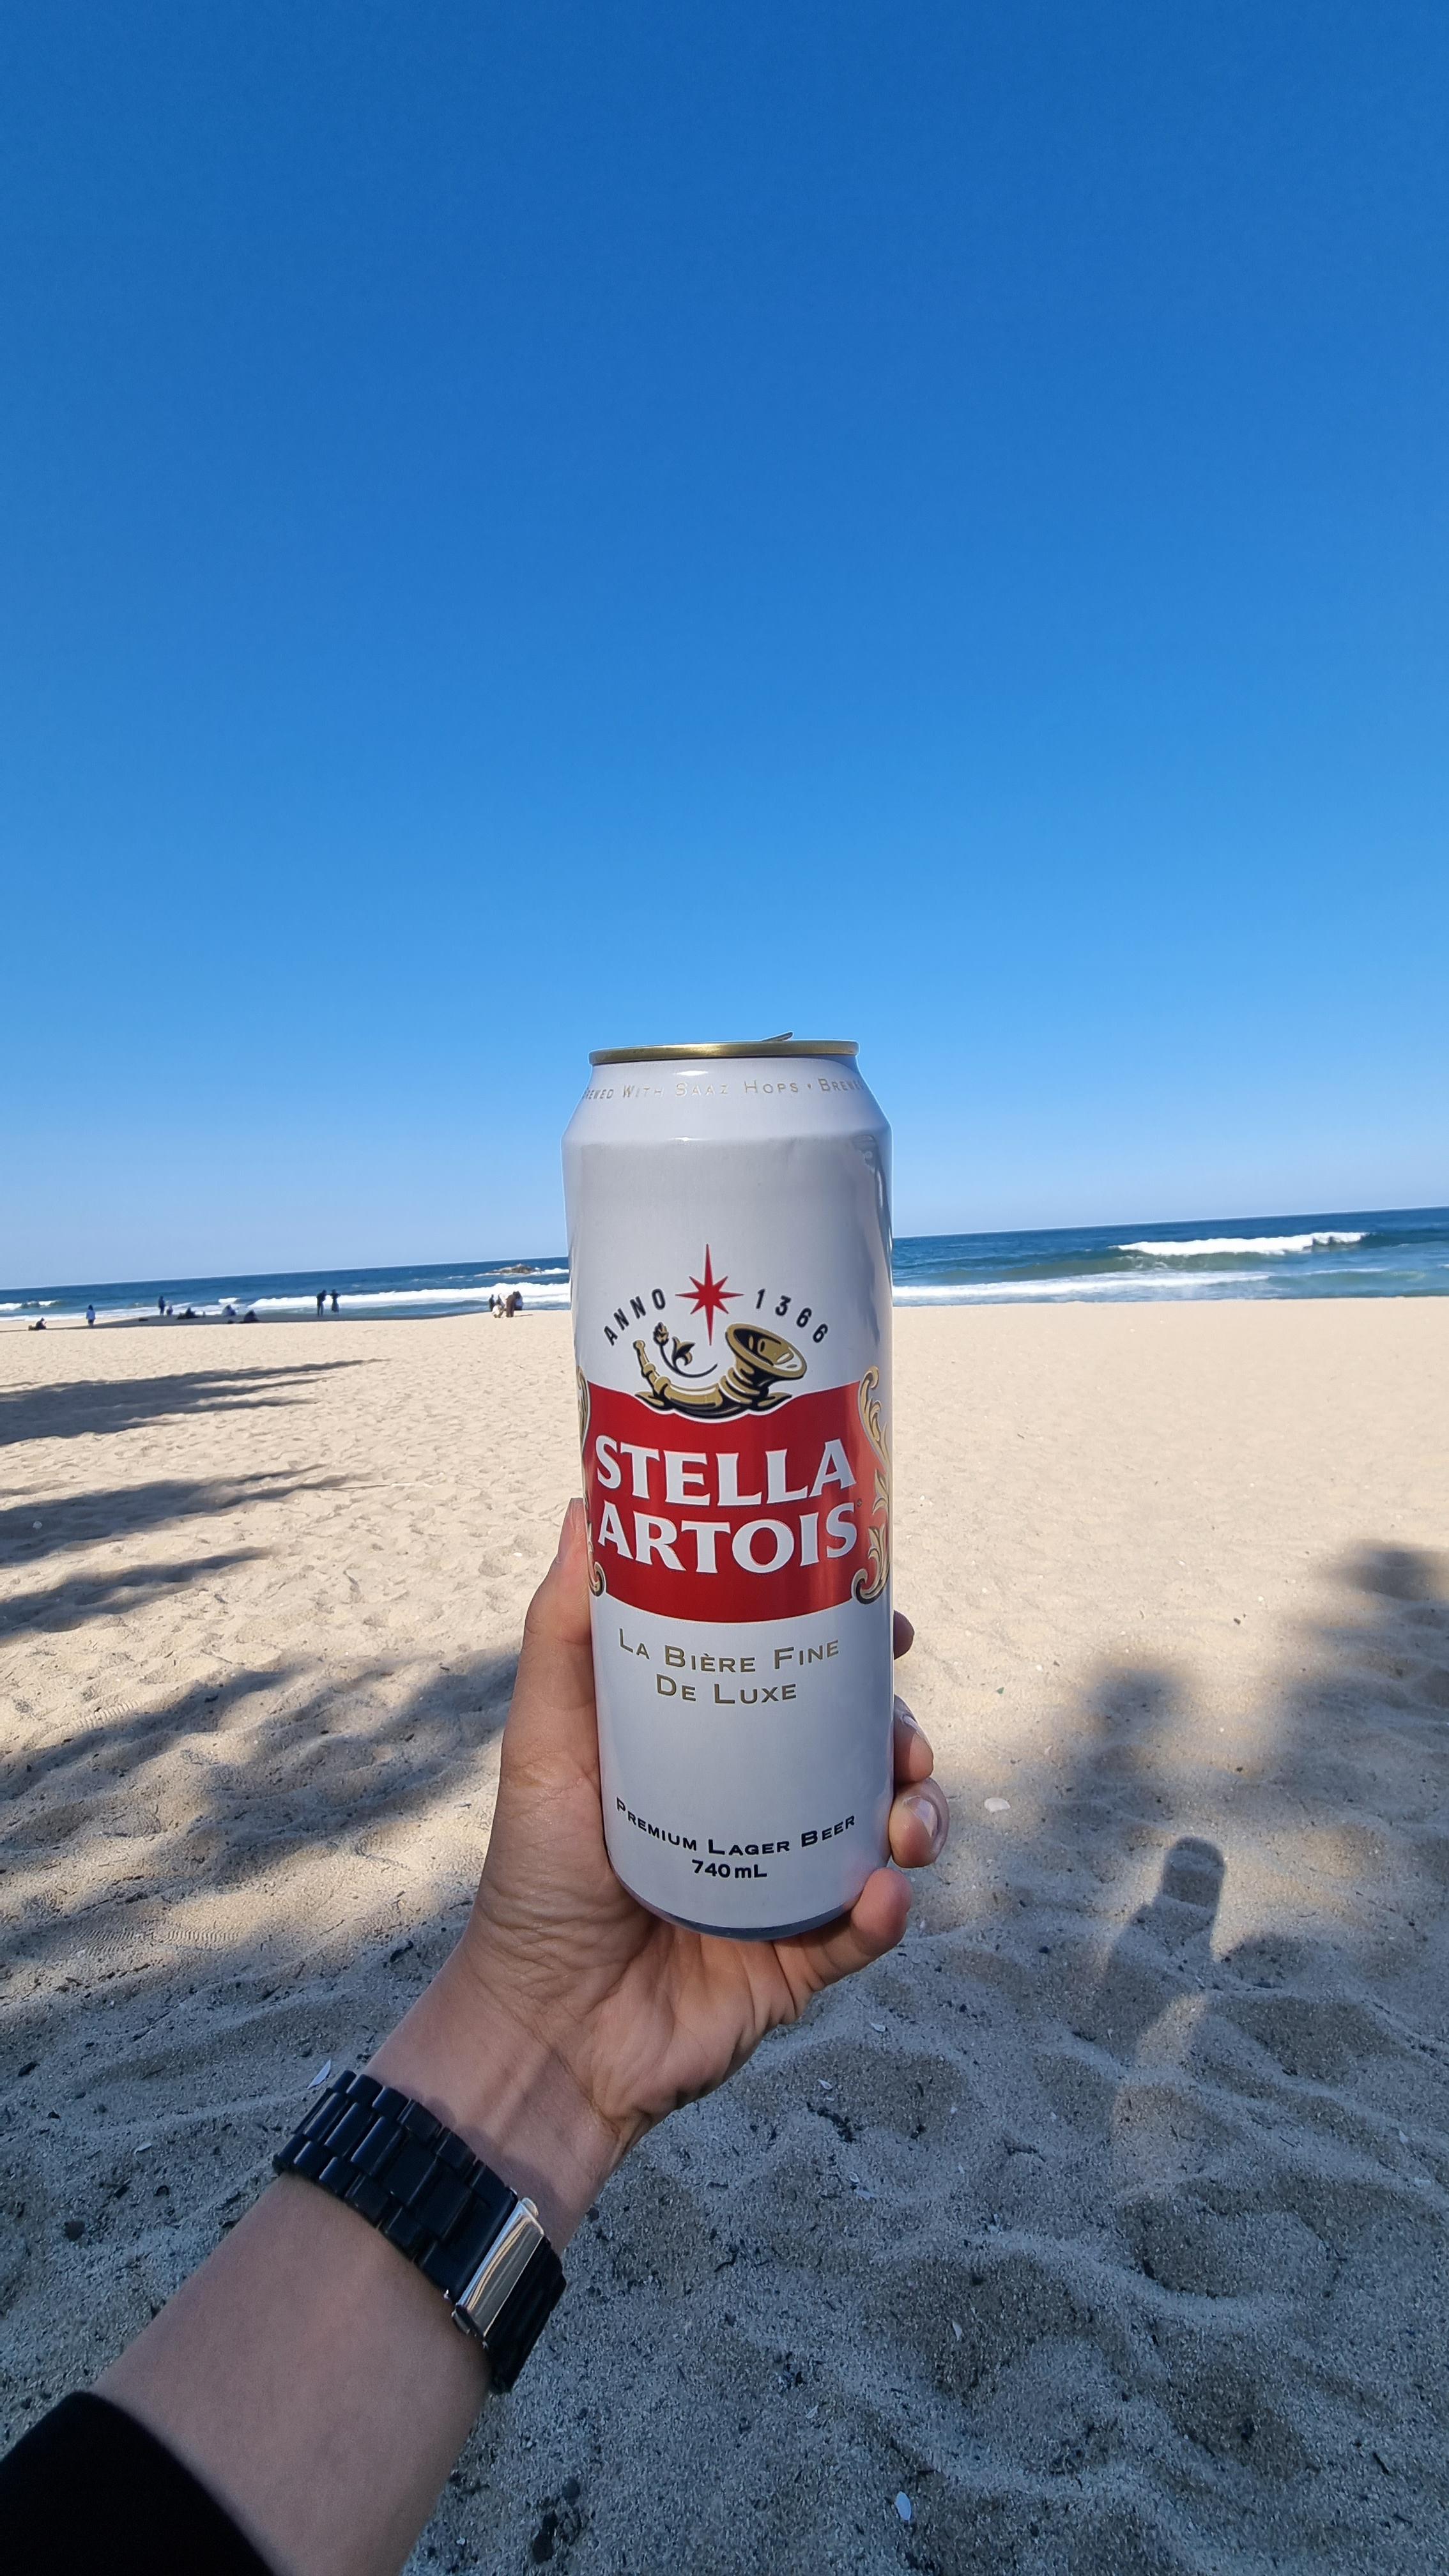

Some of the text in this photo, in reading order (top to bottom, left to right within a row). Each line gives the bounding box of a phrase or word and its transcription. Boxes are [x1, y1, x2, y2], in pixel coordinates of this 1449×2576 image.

[603, 1288, 828, 1346] ANNO 1366
[595, 1435, 856, 1506] STELLA
[597, 1500, 857, 1574] ARTOIS
